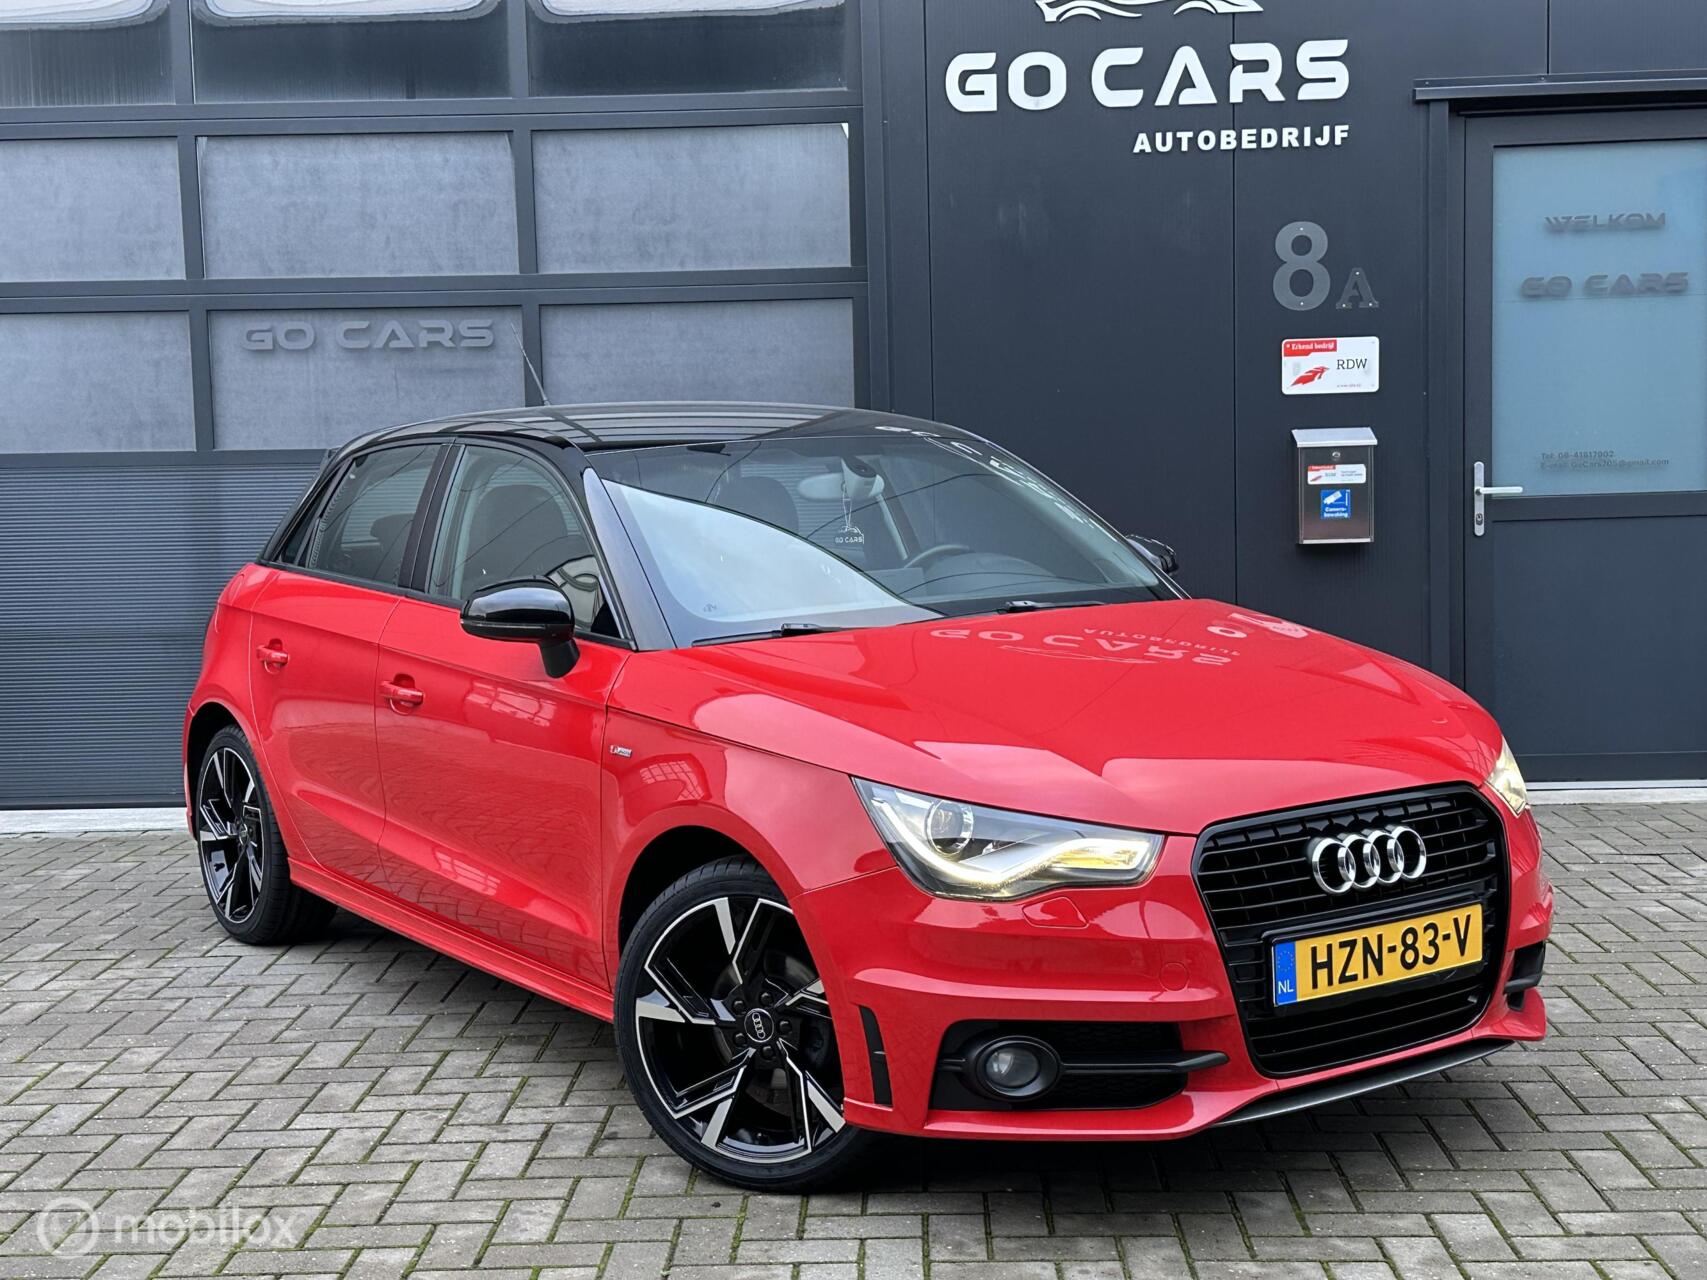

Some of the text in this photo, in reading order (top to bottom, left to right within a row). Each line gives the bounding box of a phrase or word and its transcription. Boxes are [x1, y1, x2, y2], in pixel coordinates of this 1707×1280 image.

[945, 39, 1350, 113] GO CARS
[1133, 125, 1350, 154] AUTOBEDRIJF
[1545, 212, 1666, 232] WELKOM
[1520, 272, 1689, 298] GO CARS
[245, 318, 495, 350] GO CARS
[1336, 358, 1368, 370] RDW
[1310, 914, 1472, 990] HZN-83-V
[1277, 980, 1294, 994] NL
